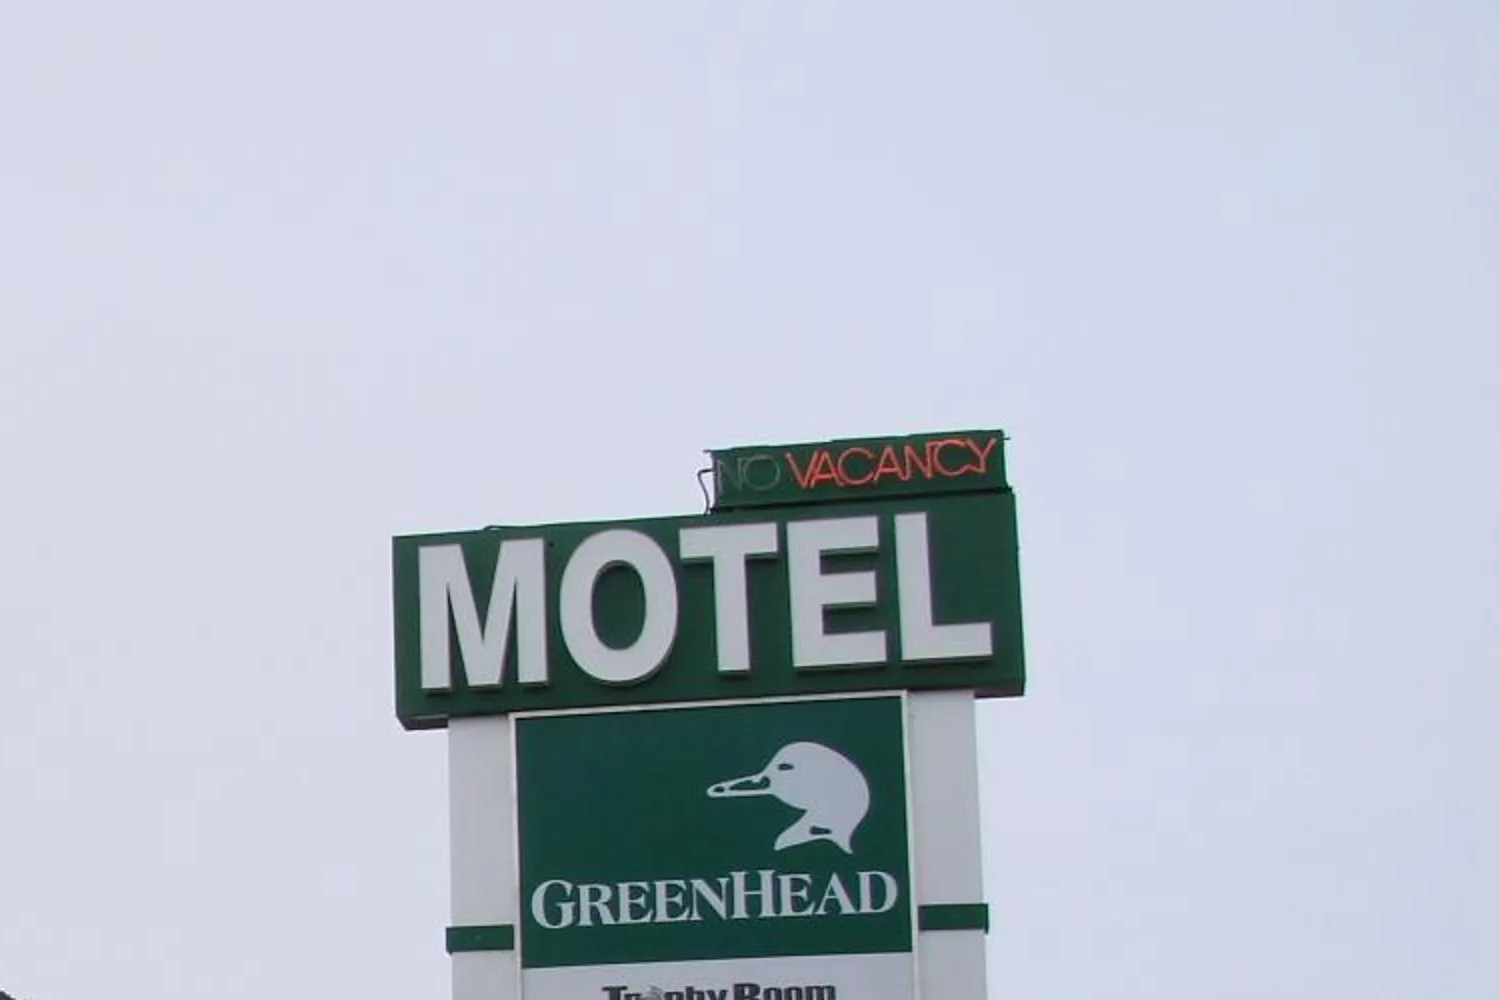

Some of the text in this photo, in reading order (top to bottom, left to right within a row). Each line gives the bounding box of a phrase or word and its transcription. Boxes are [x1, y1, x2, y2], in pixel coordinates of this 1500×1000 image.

[715, 437, 997, 492] NO VACANCY
[418, 512, 994, 690] MOTEL
